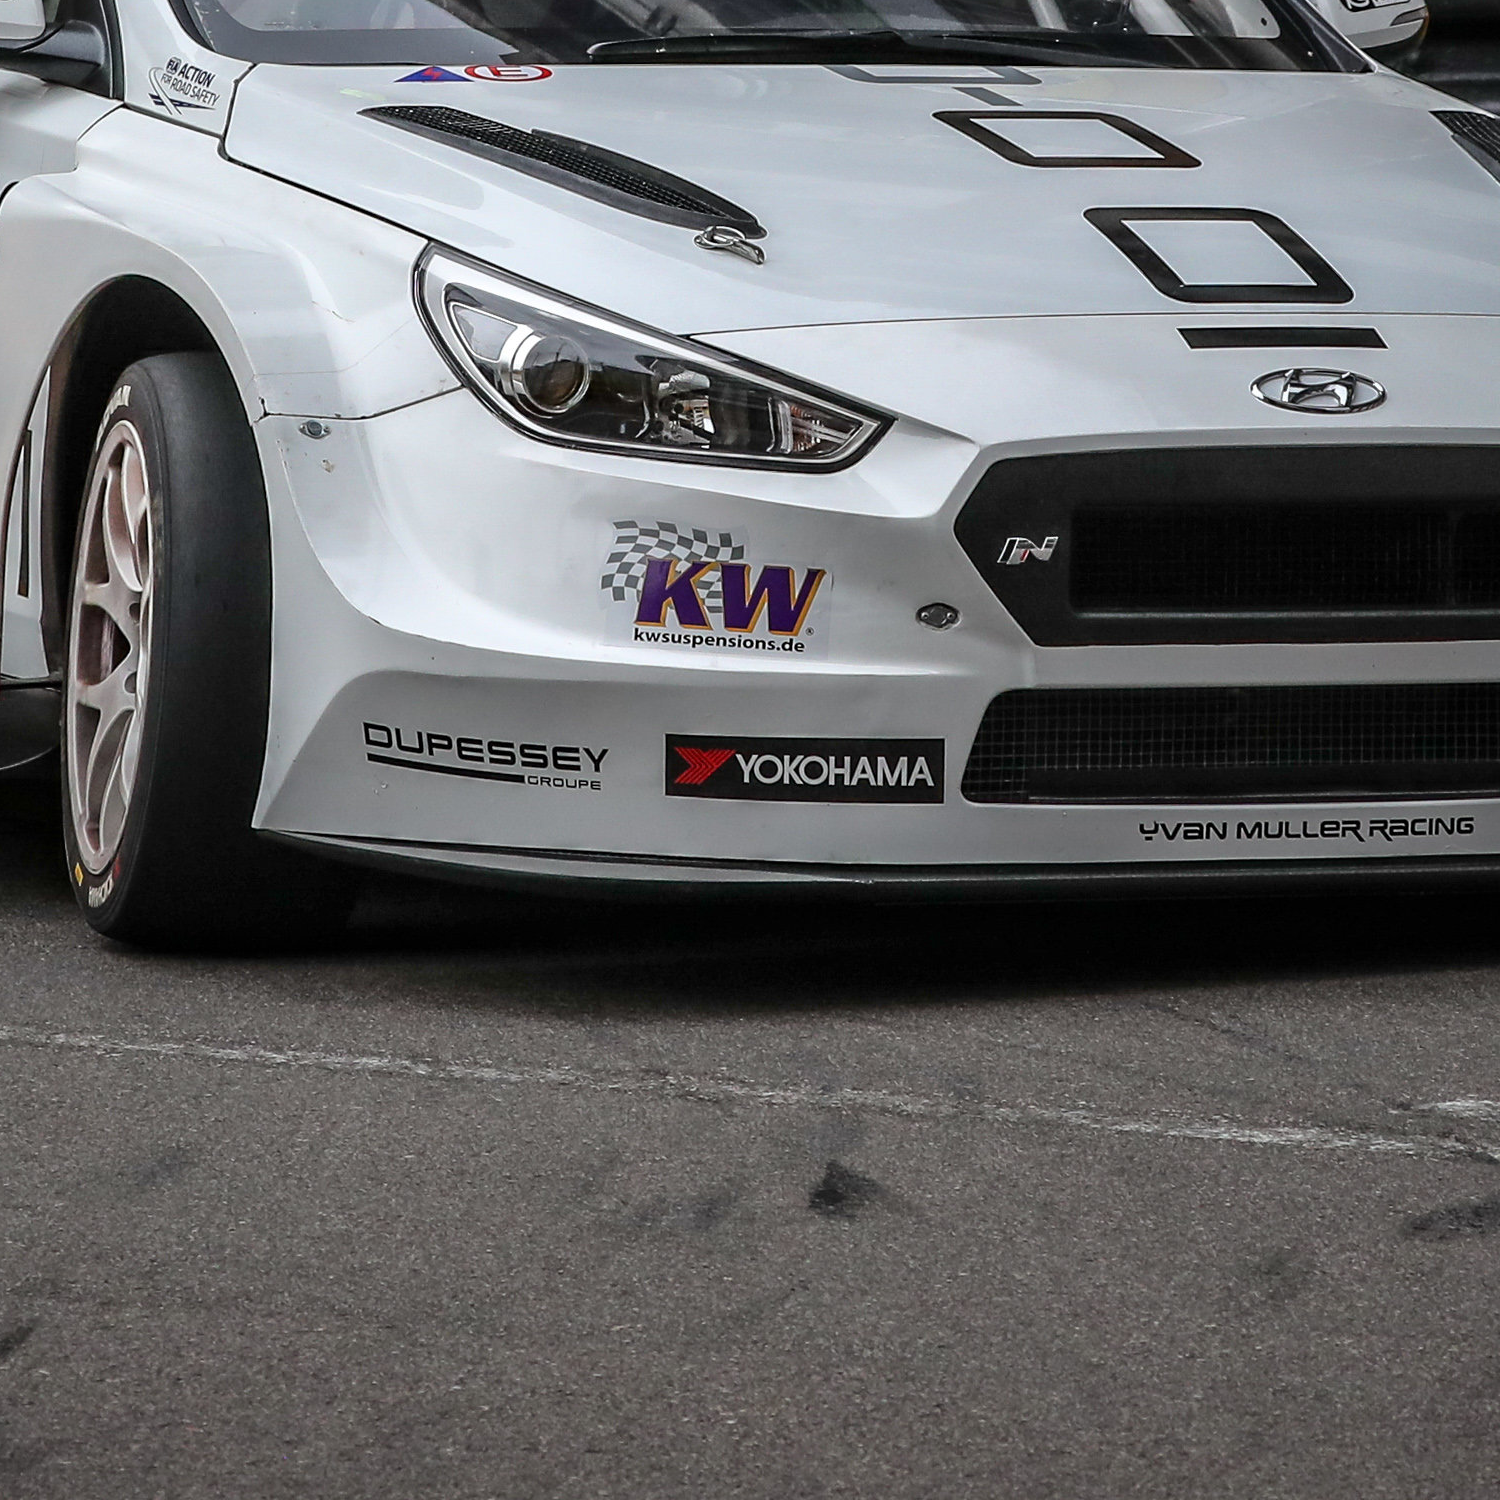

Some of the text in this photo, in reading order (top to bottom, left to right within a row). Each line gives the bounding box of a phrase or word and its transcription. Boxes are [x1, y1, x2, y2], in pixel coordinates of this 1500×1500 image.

[161, 73, 220, 106] FOR ROAD SAFETY
[178, 62, 216, 88] ACTION
[634, 556, 827, 636] KW
[633, 628, 806, 654] kwsuspensions.de
[362, 720, 610, 775] DUPESSEY
[526, 774, 602, 791] GROUPE
[735, 752, 935, 789] YOKOHAMA
[1235, 818, 1366, 843] MULLER
